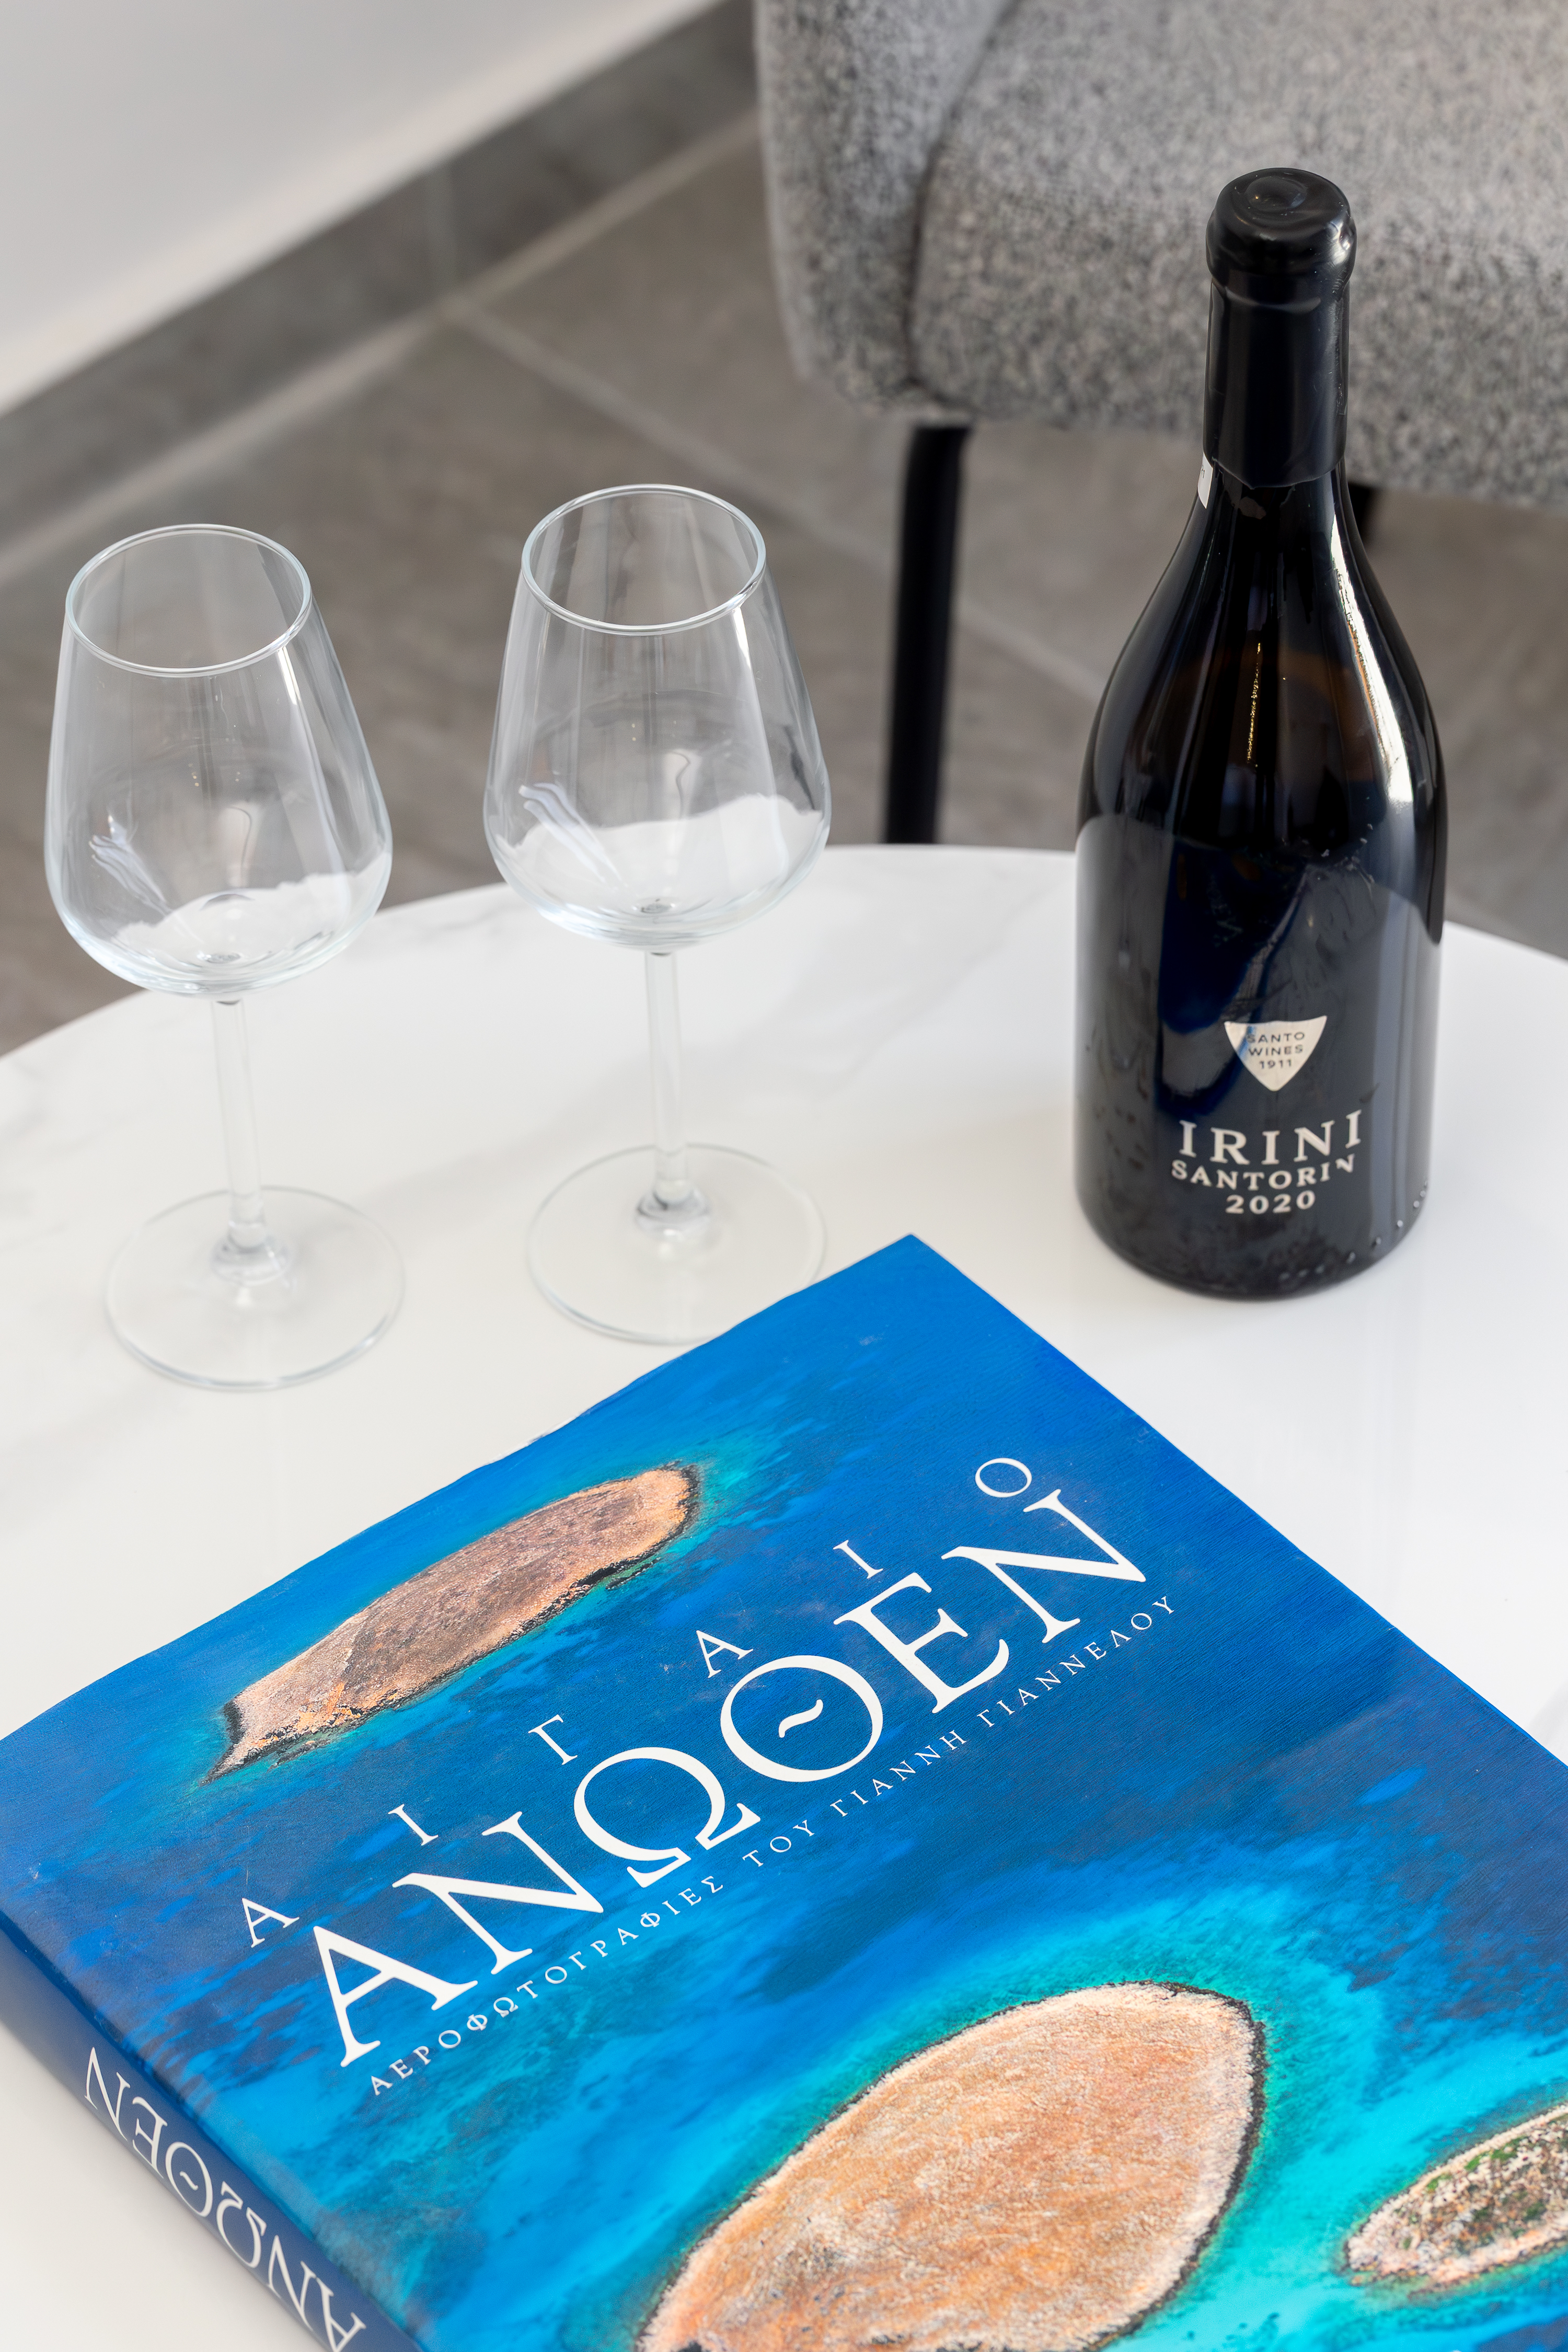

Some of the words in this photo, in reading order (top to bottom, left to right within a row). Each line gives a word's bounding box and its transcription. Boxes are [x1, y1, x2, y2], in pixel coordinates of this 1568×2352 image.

[1249, 1044, 1304, 1056] WINES
[1260, 1059, 1293, 1069] 1911
[1179, 1110, 1362, 1165] IRINI
[1171, 1154, 1355, 1191] SANTORIN
[1226, 1191, 1315, 1214] 2020
[314, 1489, 1146, 2067] ΑΝΩΘΕΝ
[371, 1875, 723, 2095] ΑΕΡΟΦΩΤΟΓΡΑΦΙΕΣ
[742, 1820, 815, 1867] ΤΟΥ
[830, 1730, 967, 1817] ΓΙΑΝΝΗ
[977, 1596, 1174, 1727] ΓΙΑΝΝΕΛΟΥ
